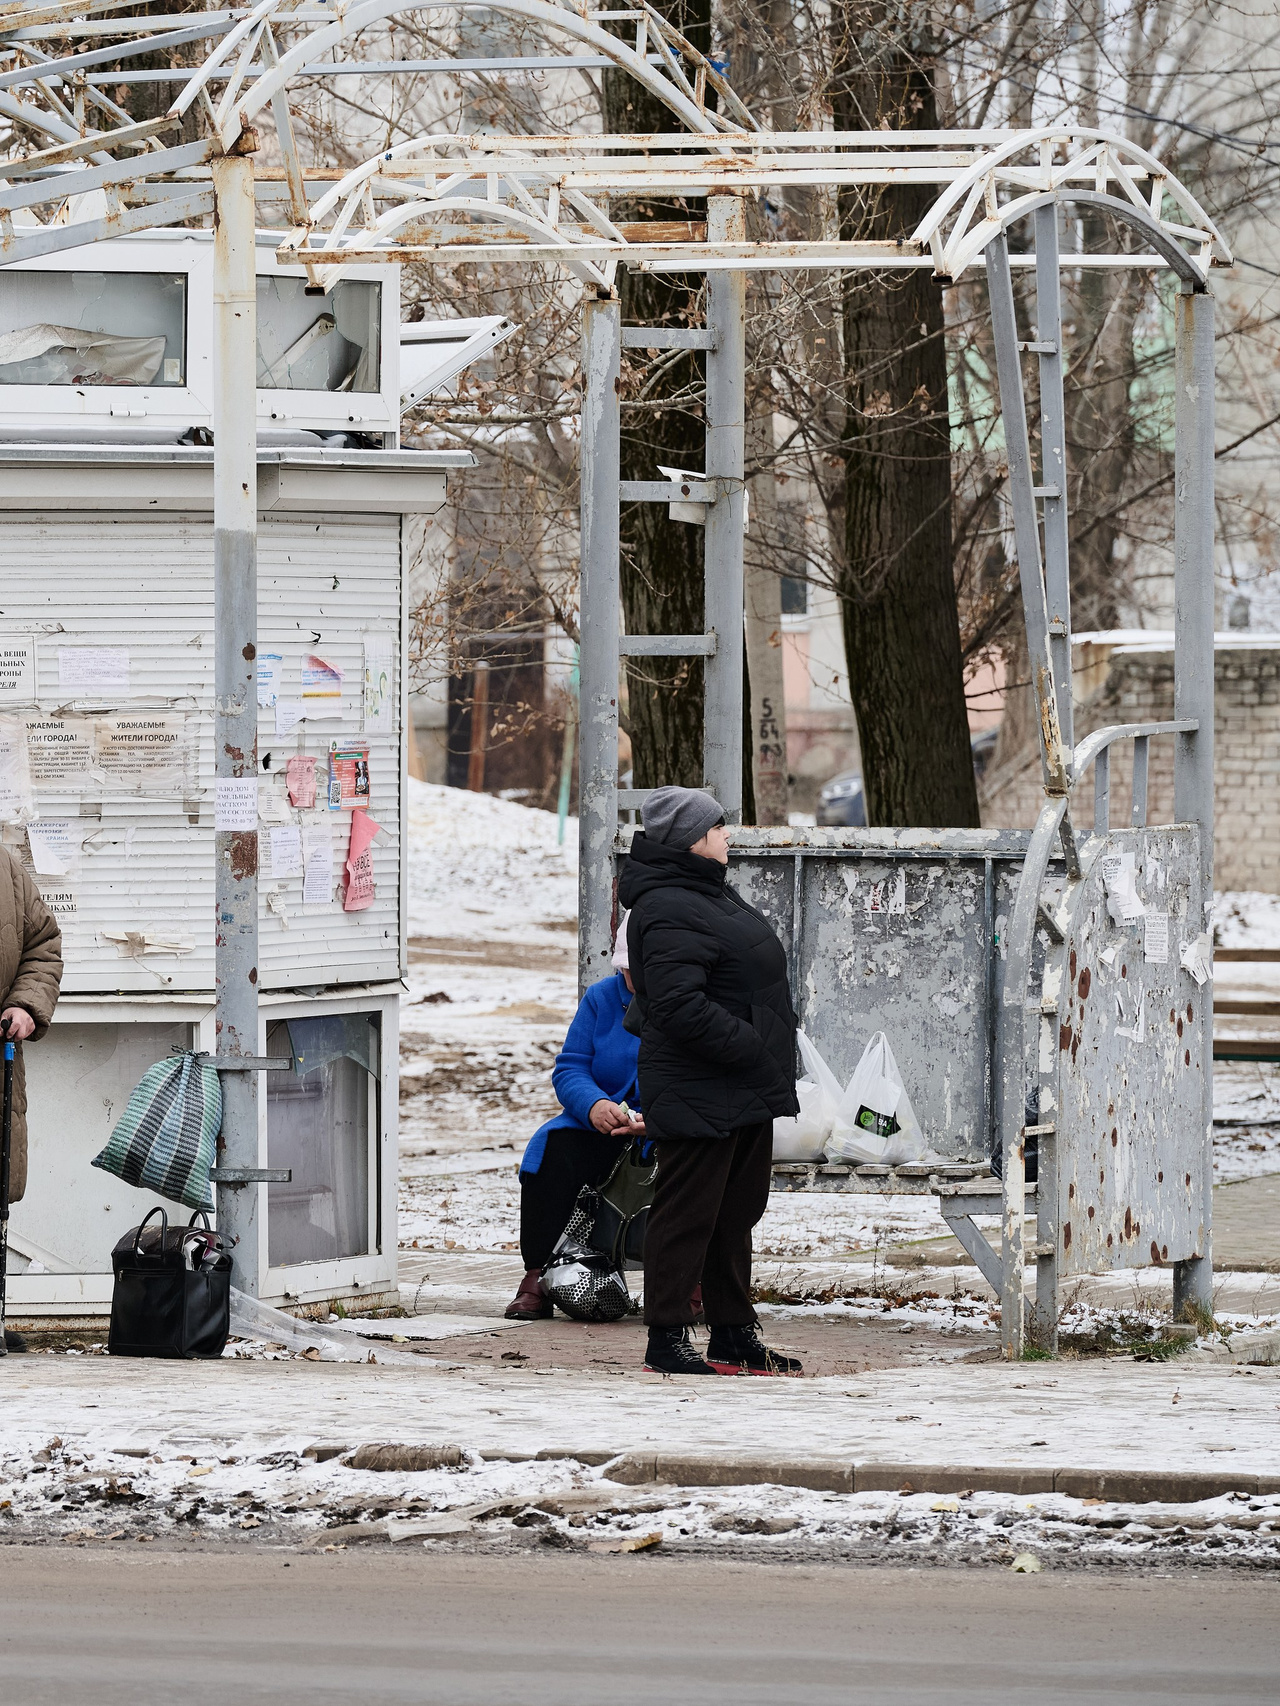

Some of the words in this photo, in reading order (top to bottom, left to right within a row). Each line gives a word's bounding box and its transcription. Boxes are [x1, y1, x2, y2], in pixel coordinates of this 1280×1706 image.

[4, 650, 27, 658] ВЕЩИ
[762, 697, 773, 718] 5
[760, 723, 779, 740] 64
[43, 734, 77, 742] ГОРОДА!
[111, 734, 143, 742] ЖИТЕЛИ
[144, 734, 178, 742] ГОРОДА!
